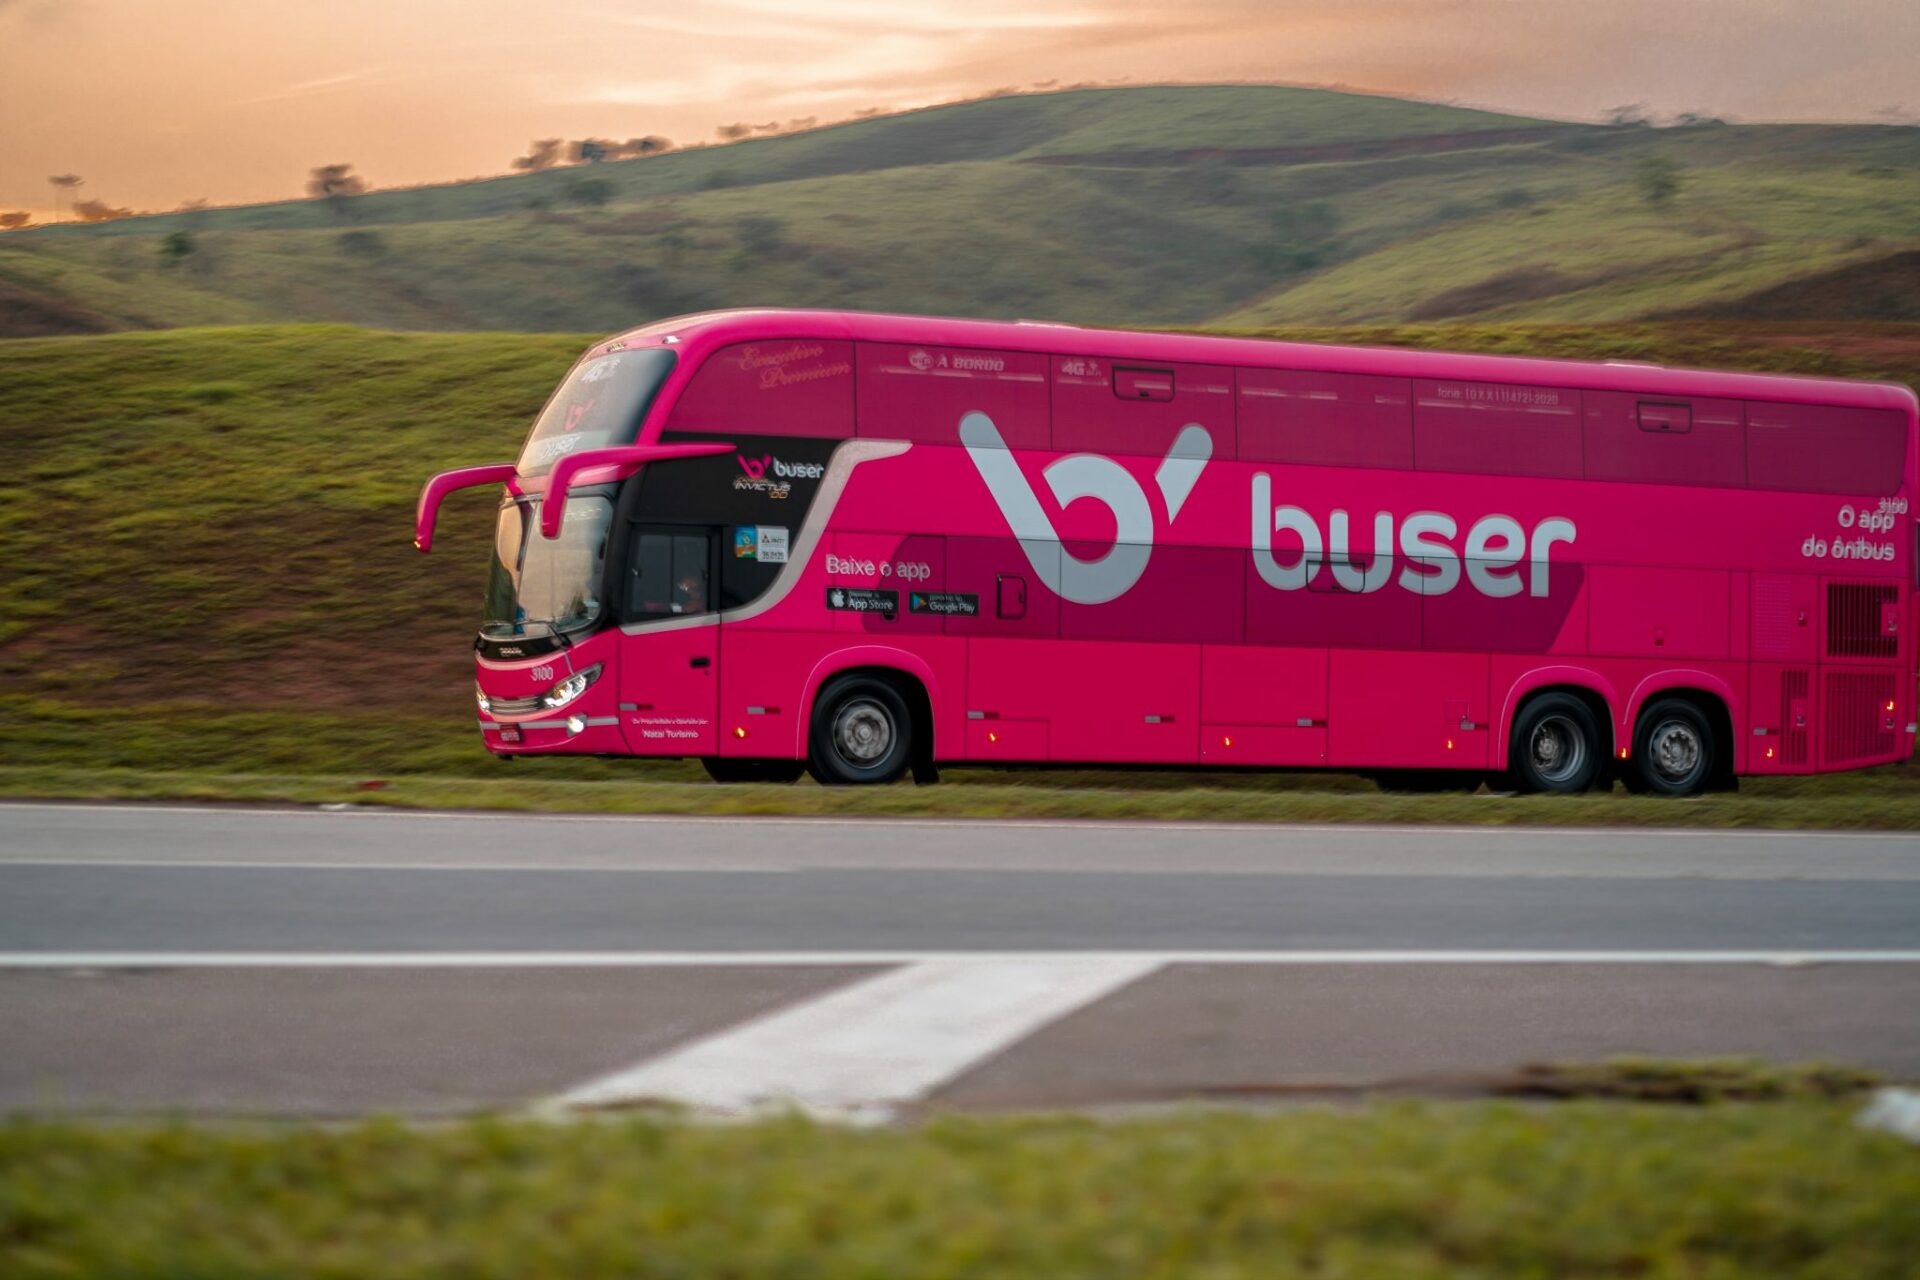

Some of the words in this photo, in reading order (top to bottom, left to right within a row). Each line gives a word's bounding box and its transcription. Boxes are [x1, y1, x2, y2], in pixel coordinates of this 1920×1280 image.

[1061, 360, 1086, 376] 4G
[773, 456, 825, 479] buser
[1837, 504, 1855, 528] O
[1858, 508, 1895, 533] app
[1251, 471, 1577, 599] buser
[1801, 533, 1827, 558] do
[1831, 535, 1895, 561] ônibus
[825, 553, 876, 576] Baixe
[879, 561, 892, 577] o
[897, 562, 931, 582] app
[848, 597, 868, 612] App
[869, 599, 894, 611] Store
[929, 600, 958, 613] Google
[959, 602, 975, 614] Play
[530, 664, 554, 682] 3100
